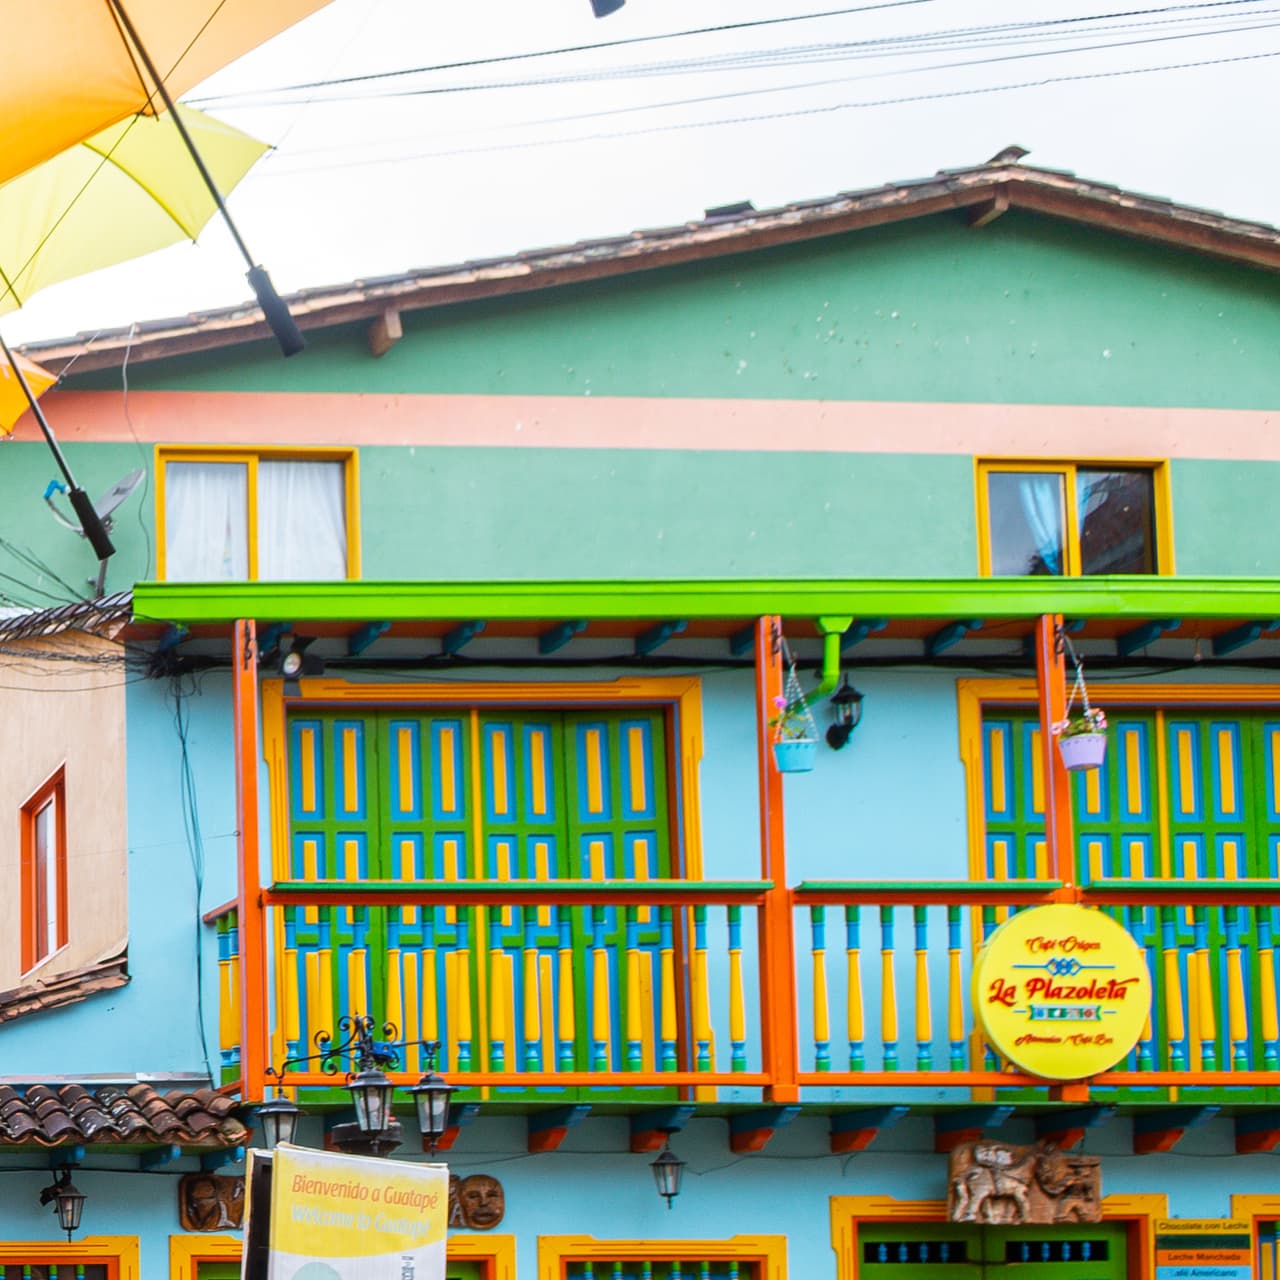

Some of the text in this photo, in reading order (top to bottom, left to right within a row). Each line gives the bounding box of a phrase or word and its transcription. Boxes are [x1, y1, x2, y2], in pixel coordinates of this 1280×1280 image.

[989, 977, 1139, 1007] La Plazoleta
[292, 1174, 438, 1212] Bienvenido a Guatapé
[291, 1204, 431, 1240] Welcome to Guatapé
[1159, 1222, 1202, 1230] Chocolate
[1223, 1222, 1248, 1230] Leche
[1191, 1269, 1237, 1277] Americano
